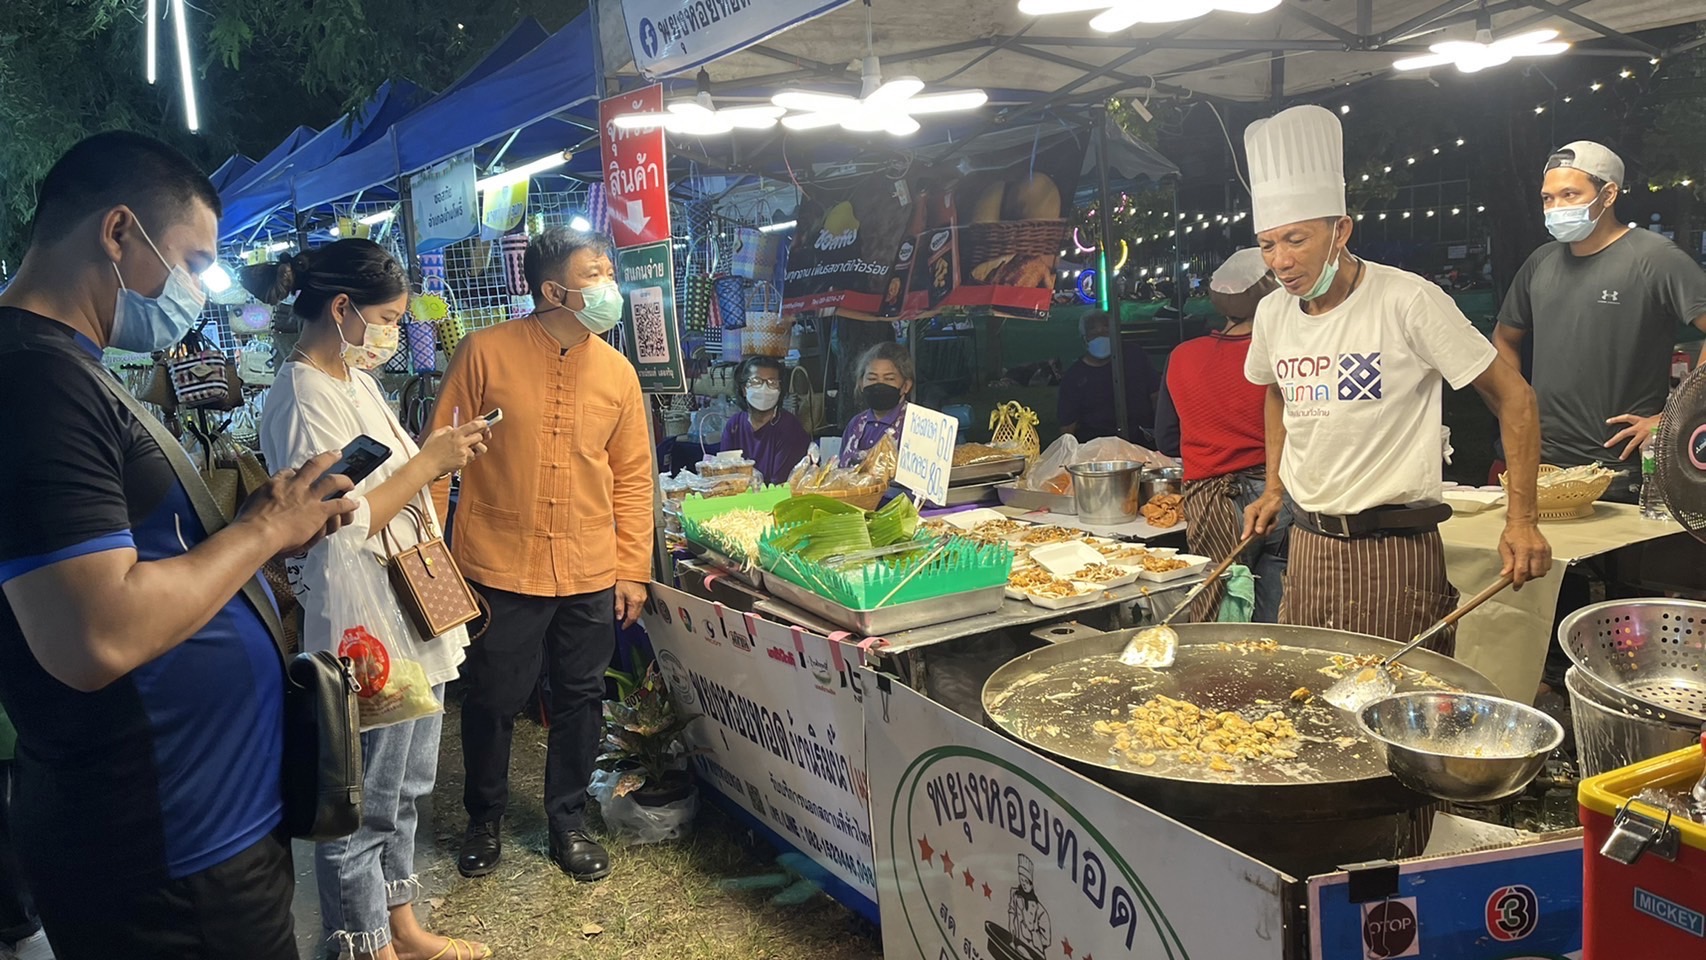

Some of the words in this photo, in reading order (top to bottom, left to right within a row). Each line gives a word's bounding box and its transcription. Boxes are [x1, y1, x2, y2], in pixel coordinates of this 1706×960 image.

[609, 152, 659, 196] สินค้า
[624, 258, 665, 282] สแกนจ่าย
[1277, 356, 1331, 379] OTOP
[937, 418, 953, 462] 60
[625, 690, 641, 708] HOT
[689, 669, 794, 765] พยุงหอยทอด
[927, 771, 1137, 951] พยุงหอยทอด
[940, 902, 956, 937] สด
[1369, 916, 1412, 934] OTOP
[1640, 893, 1698, 930] MICKEY
